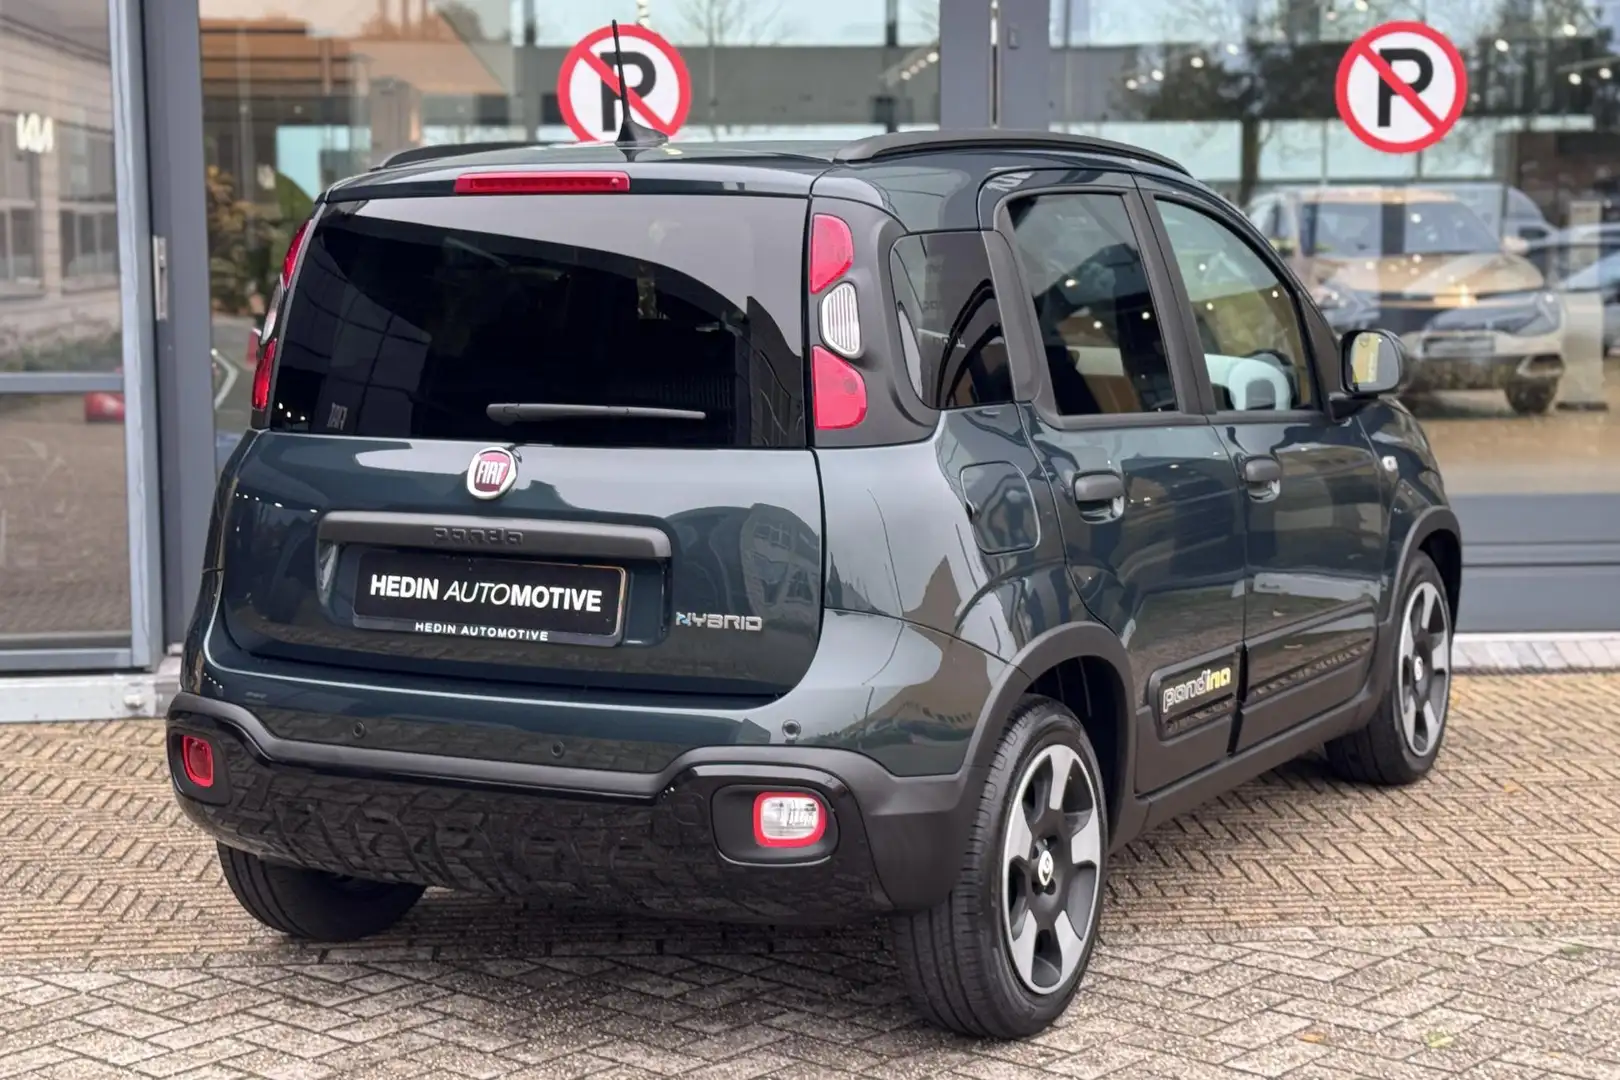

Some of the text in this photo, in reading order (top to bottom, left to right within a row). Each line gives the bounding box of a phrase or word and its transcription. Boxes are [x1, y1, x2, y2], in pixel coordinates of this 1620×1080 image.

[600, 51, 656, 132] P
[1377, 48, 1434, 127] P
[475, 460, 508, 485] FIAT
[370, 574, 602, 612] HEDIN AUTOMOTIVE
[415, 621, 548, 641] HEDIN AUTOMOTIVE
[675, 611, 763, 632] HYBRID
[1162, 667, 1231, 713] pandina
